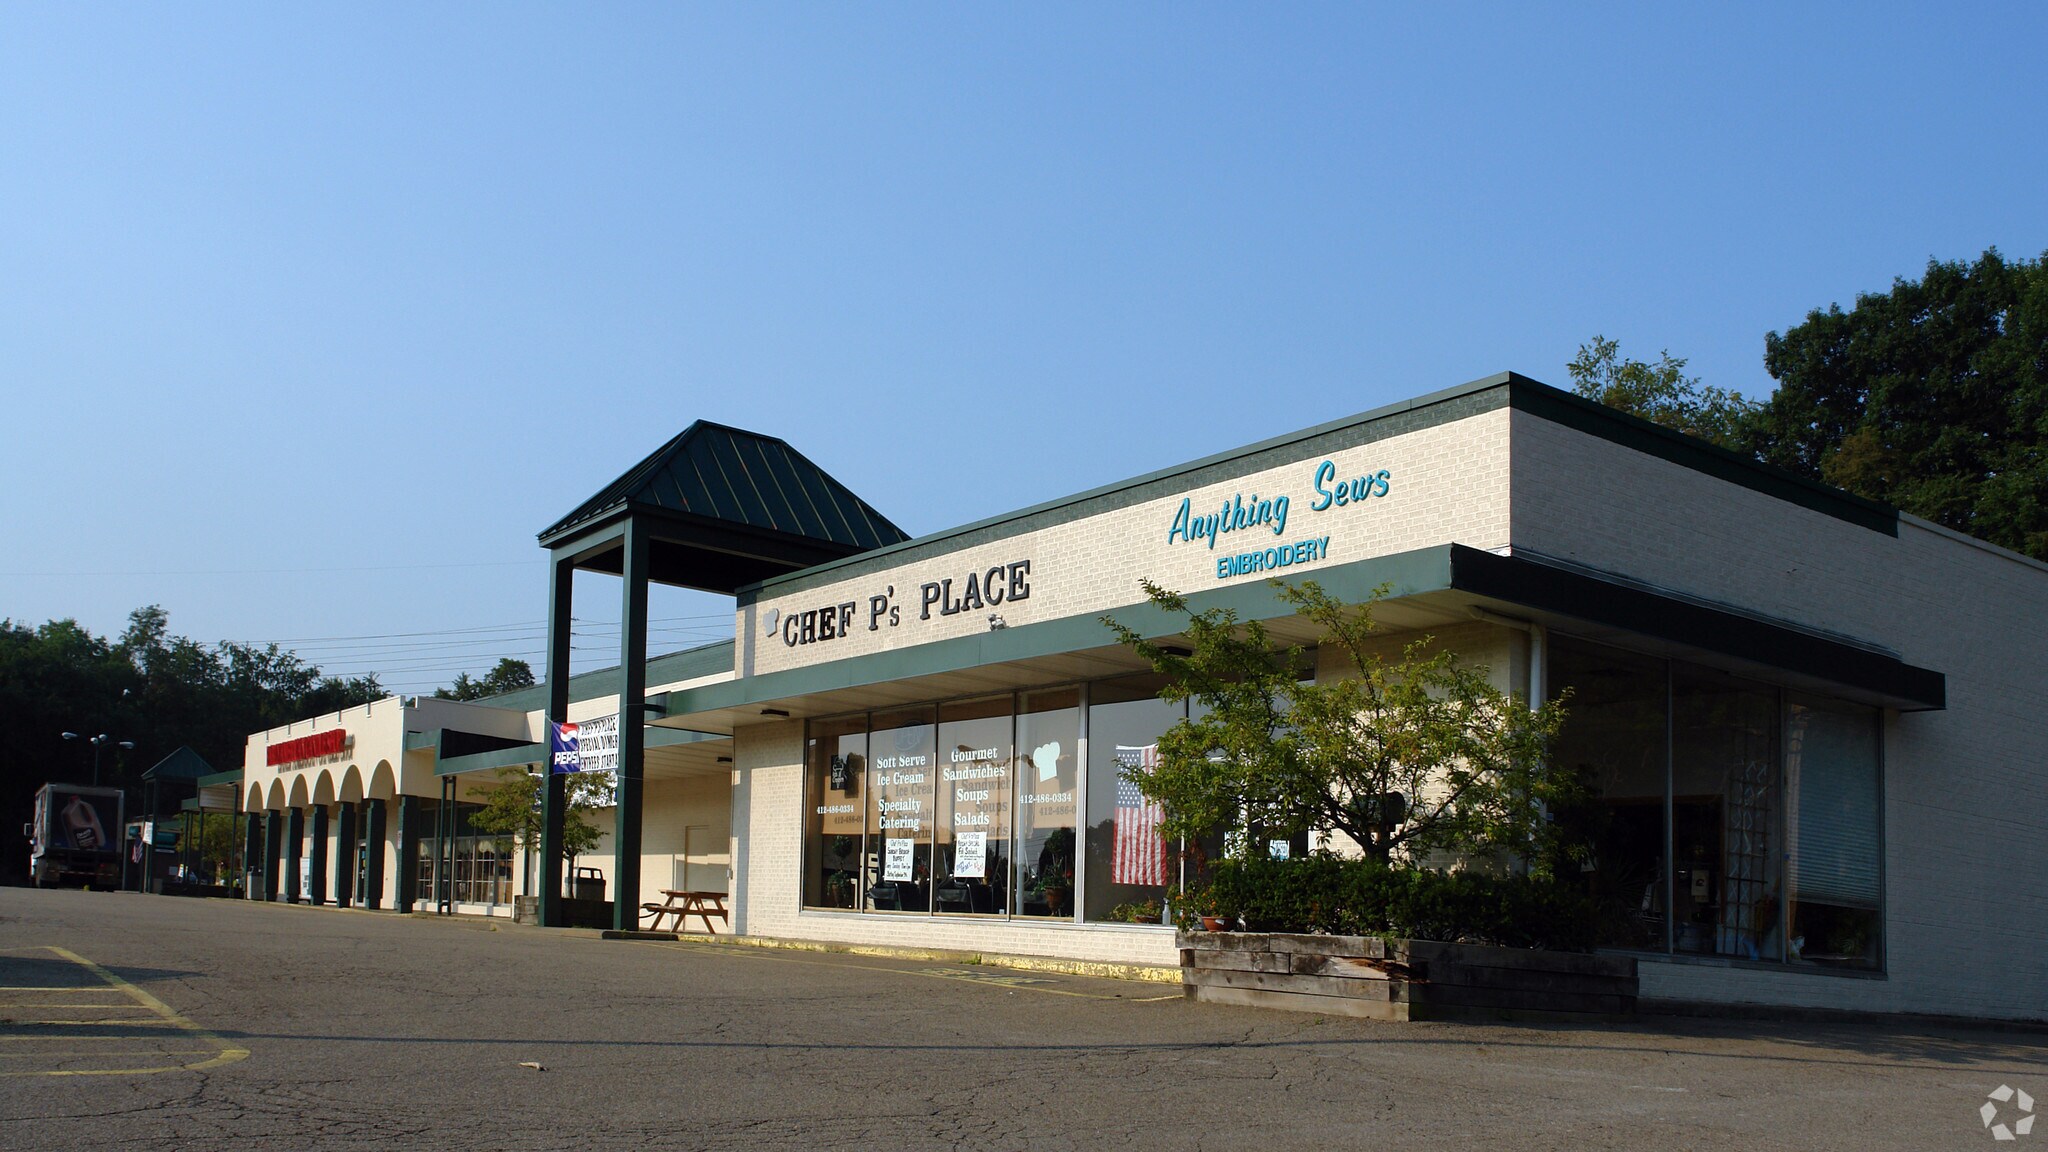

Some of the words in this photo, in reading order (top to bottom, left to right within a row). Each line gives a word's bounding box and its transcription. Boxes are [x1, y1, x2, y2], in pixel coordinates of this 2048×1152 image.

[1168, 493, 1289, 549] Anything
[1311, 460, 1391, 511] Sews
[1217, 536, 1329, 579] EMBROIDERY
[782, 601, 857, 647] CHEF
[920, 559, 1031, 620] PLACE
[555, 752, 580, 765] PEPSI
[899, 754, 926, 768] Serve
[951, 747, 998, 763] Gourmet
[877, 774, 891, 786] Ice
[893, 772, 925, 785] Cream
[943, 765, 1006, 782] Sandwiches
[956, 788, 989, 804] Soups
[1019, 792, 1072, 804] 412-486-0334
[878, 799, 922, 816] Specialty
[878, 815, 922, 832] Catering
[954, 811, 990, 827] Salads
